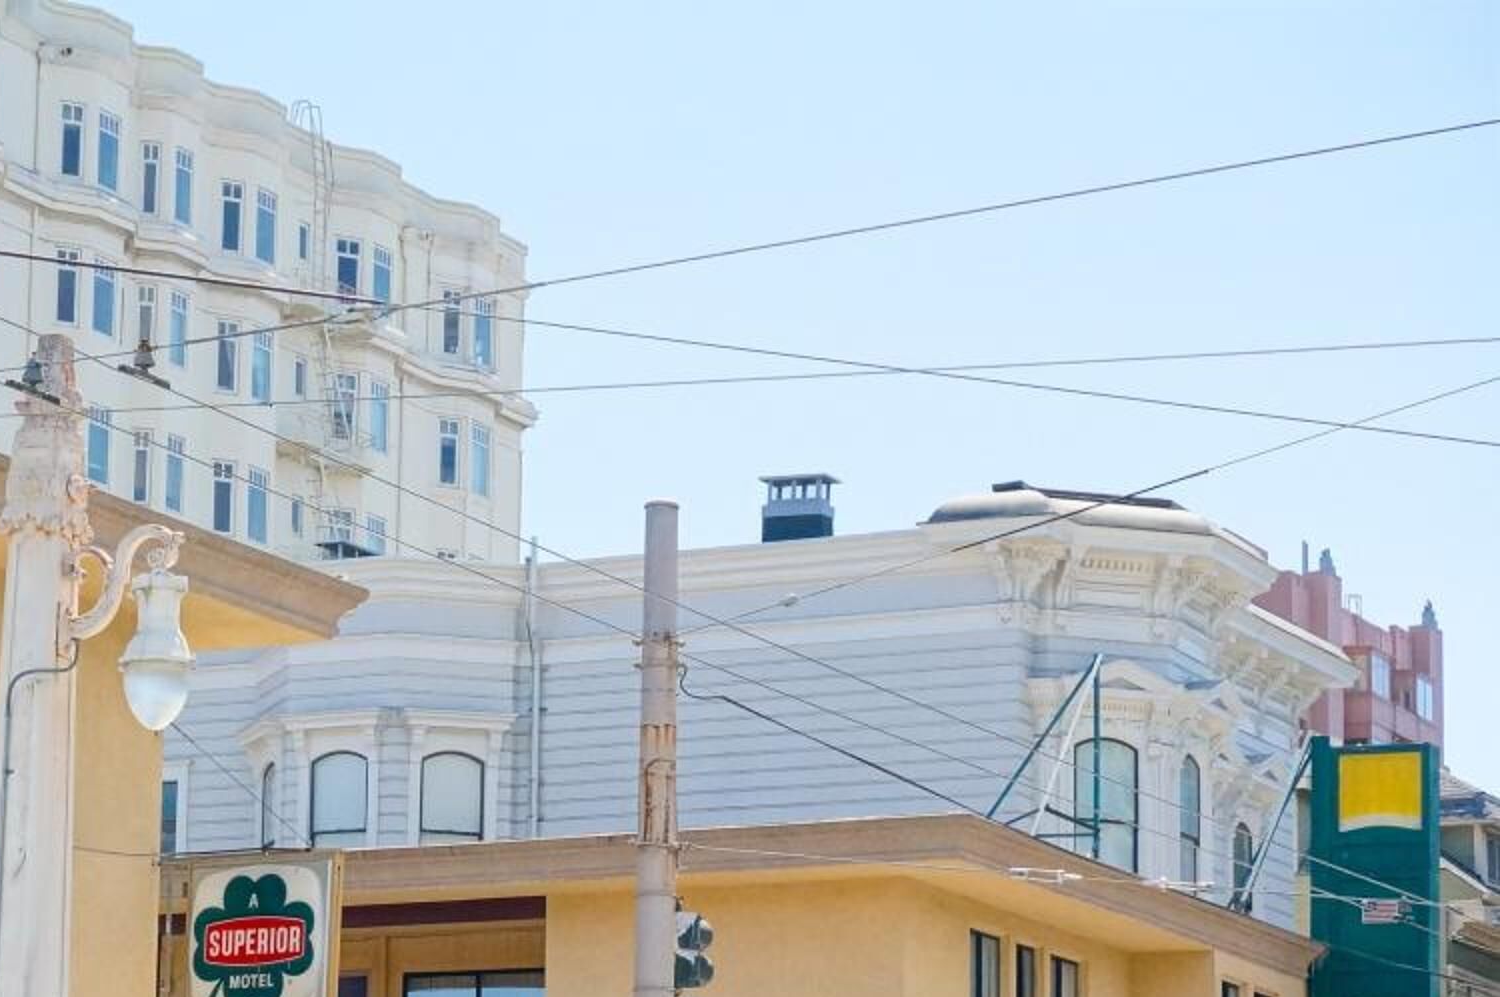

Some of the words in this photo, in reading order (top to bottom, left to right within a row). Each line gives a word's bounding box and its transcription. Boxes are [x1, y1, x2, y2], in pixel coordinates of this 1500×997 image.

[248, 893, 259, 908] A
[209, 926, 301, 957] SUPERIOR
[229, 974, 273, 989] MOTEL
